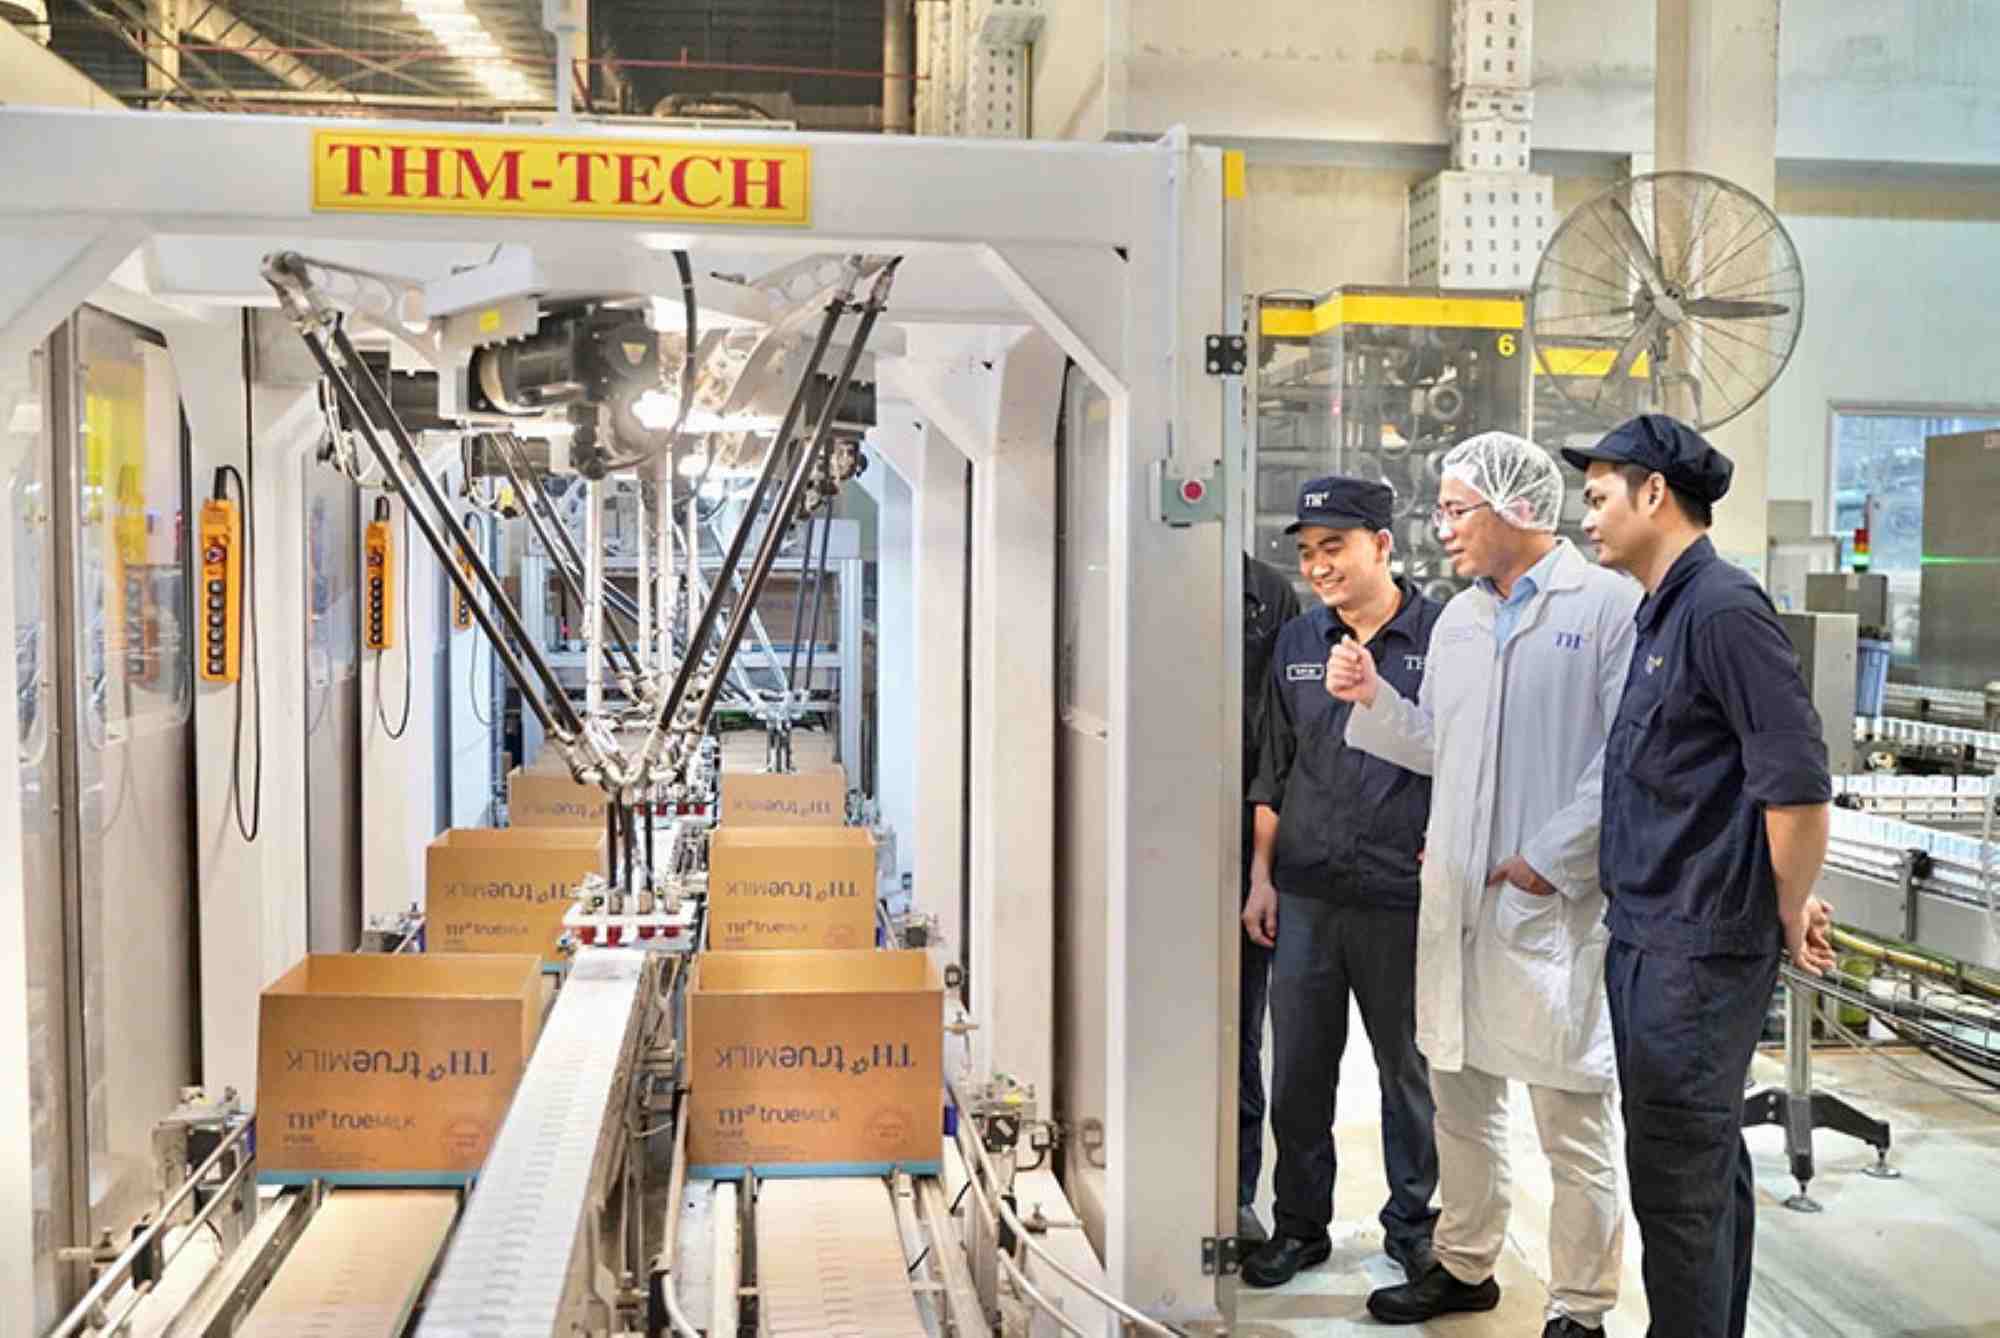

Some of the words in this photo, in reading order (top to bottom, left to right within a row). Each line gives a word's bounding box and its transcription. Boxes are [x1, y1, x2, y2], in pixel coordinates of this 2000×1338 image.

[328, 143, 786, 209] THM-TECH
[1497, 334, 1516, 357] 6
[286, 1047, 421, 1078] trueMILK
[450, 1050, 496, 1076] TH
[717, 1044, 844, 1072] trueMILK
[870, 1043, 917, 1068] TH
